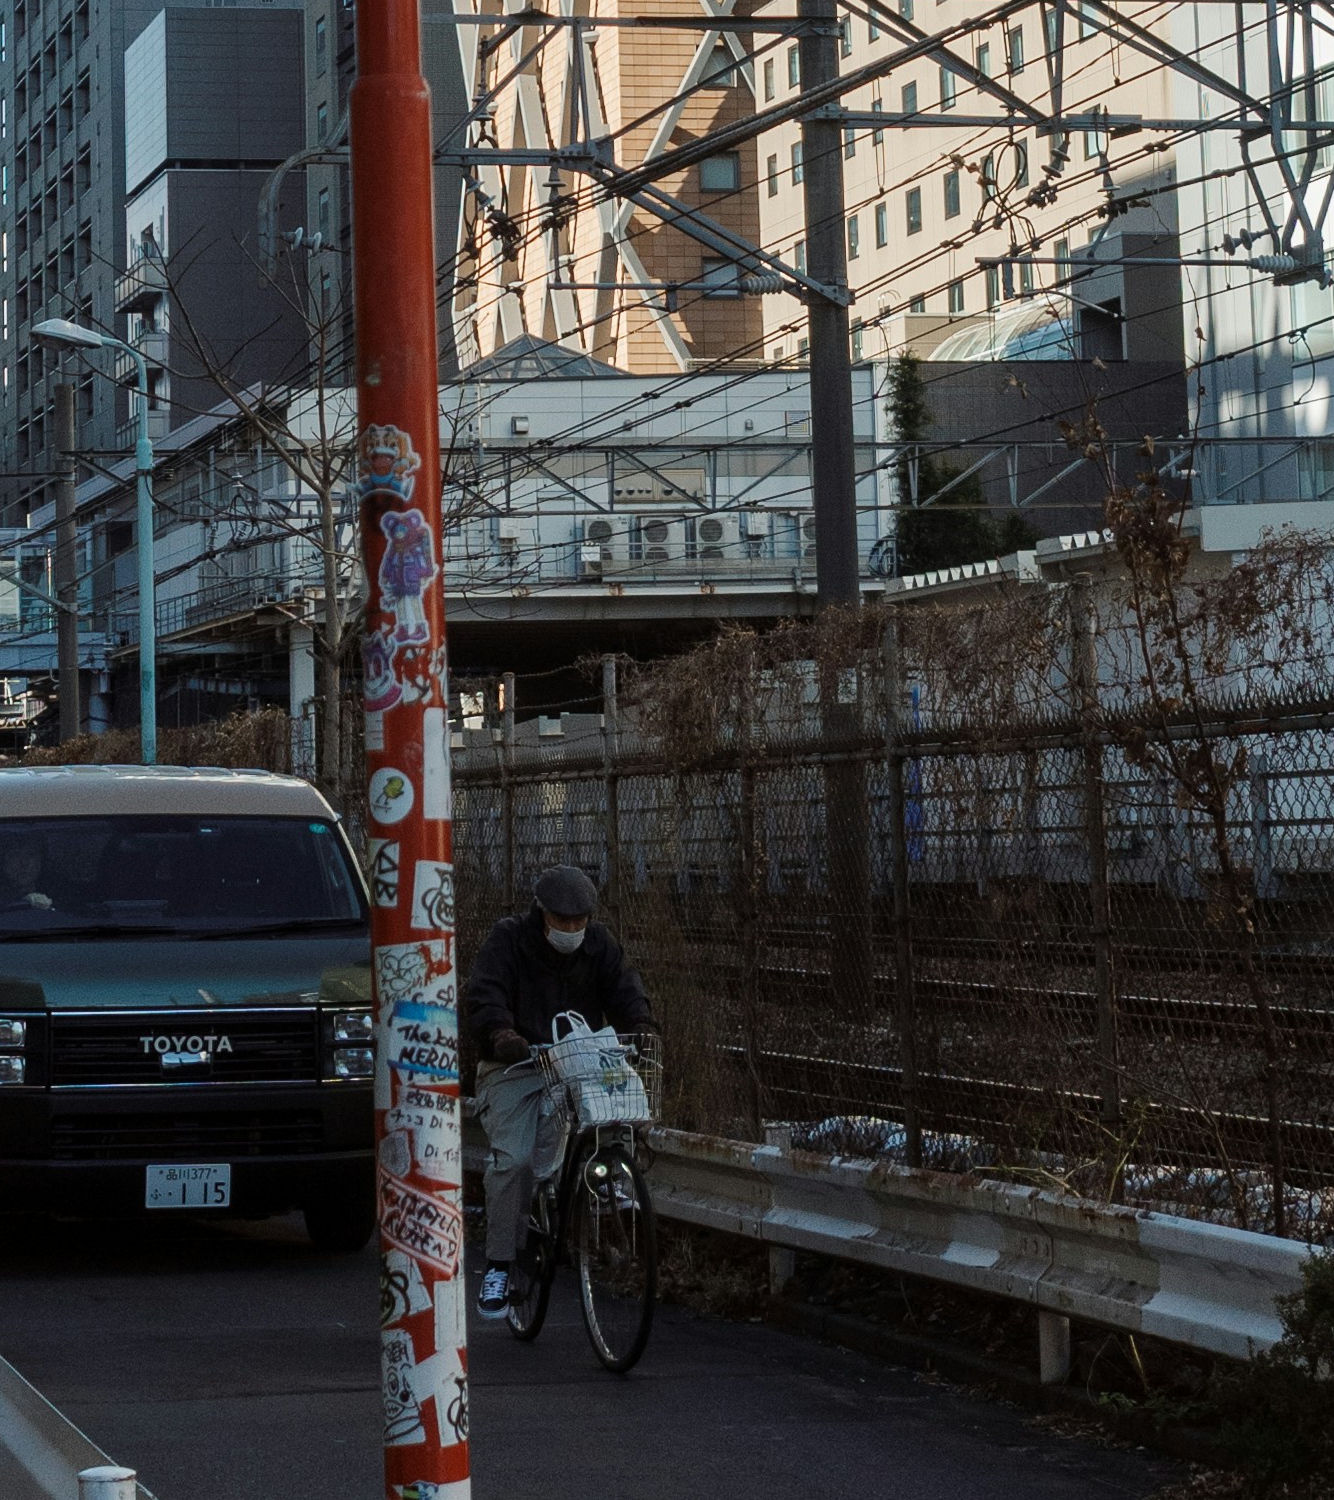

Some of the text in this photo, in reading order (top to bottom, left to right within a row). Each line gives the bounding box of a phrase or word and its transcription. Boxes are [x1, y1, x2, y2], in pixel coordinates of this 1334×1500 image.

[397, 1023, 431, 1044] The
[139, 1035, 233, 1053] TOYOTA
[150, 1187, 162, 1201] ふ
